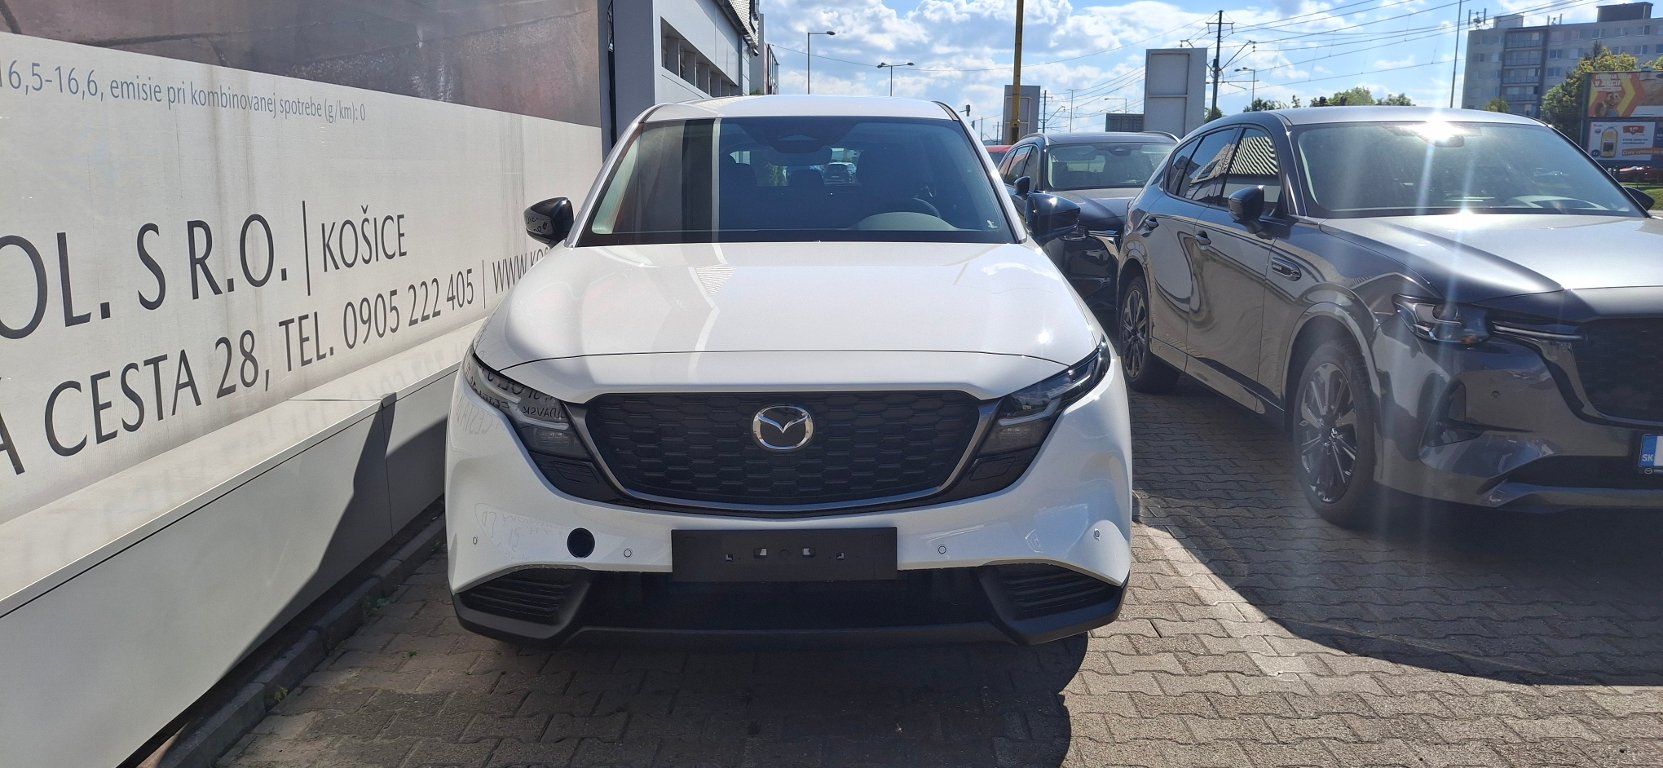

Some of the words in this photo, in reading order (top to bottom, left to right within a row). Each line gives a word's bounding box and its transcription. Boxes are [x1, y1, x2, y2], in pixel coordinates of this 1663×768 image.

[110, 75, 162, 102] emisie
[167, 81, 186, 110] pri
[191, 81, 276, 119] kombinovanej
[279, 96, 322, 120] spotrebe
[360, 103, 366, 121] 0
[137, 222, 166, 310] S
[187, 213, 288, 300] R.O.
[321, 204, 408, 272] KOŠICE
[44, 349, 202, 457] CESTA
[215, 329, 270, 399] 28,
[278, 311, 335, 372] TEL.
[343, 289, 400, 350] 0905
[407, 277, 441, 327] 222
[446, 268, 474, 311] 405
